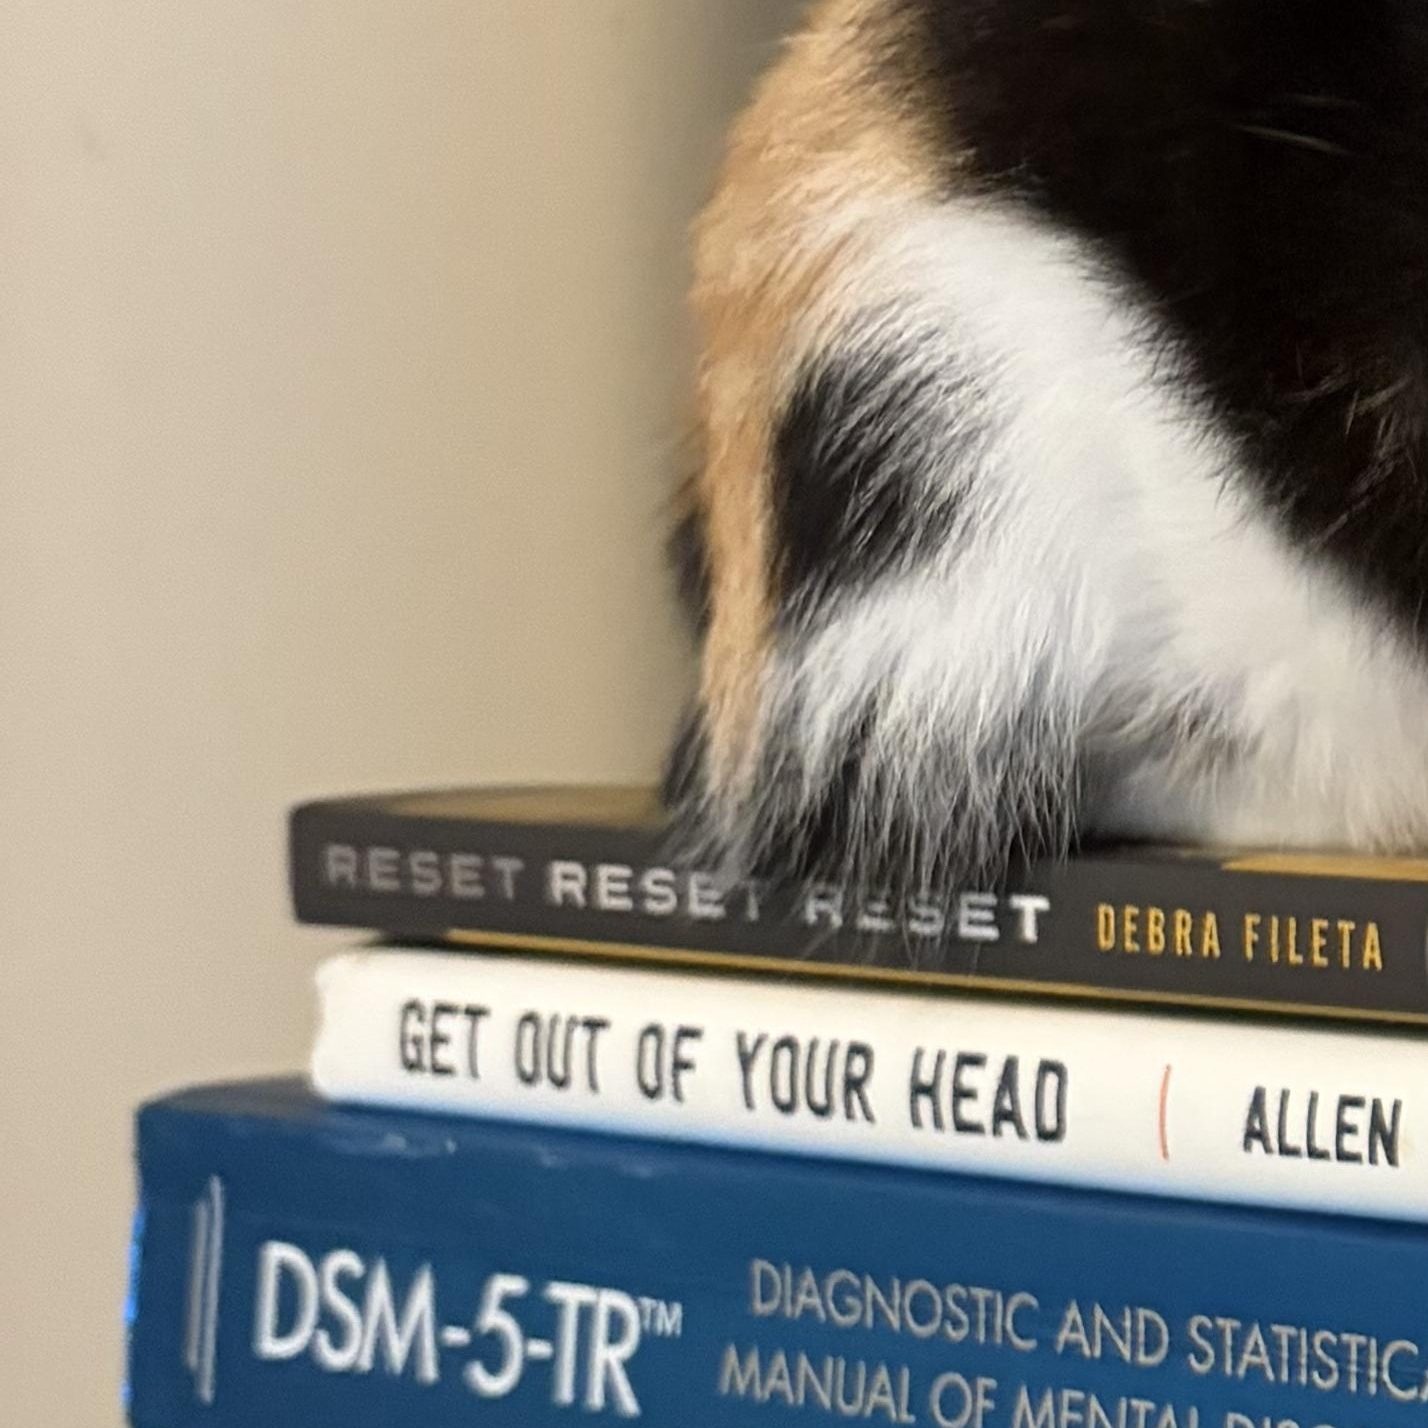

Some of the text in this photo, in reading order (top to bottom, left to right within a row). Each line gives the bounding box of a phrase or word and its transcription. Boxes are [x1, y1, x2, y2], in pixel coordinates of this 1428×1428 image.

[325, 843, 524, 899] RESET
[1097, 905, 1221, 958] DEBRA
[1244, 914, 1385, 972] FILETA
[401, 998, 1403, 1169] GET OUT OF YOUR HEAD ALLEN
[749, 1258, 1038, 1353] DIAGNOSTIC
[1057, 1302, 1171, 1365] AND
[719, 1344, 915, 1425] MANUAL
